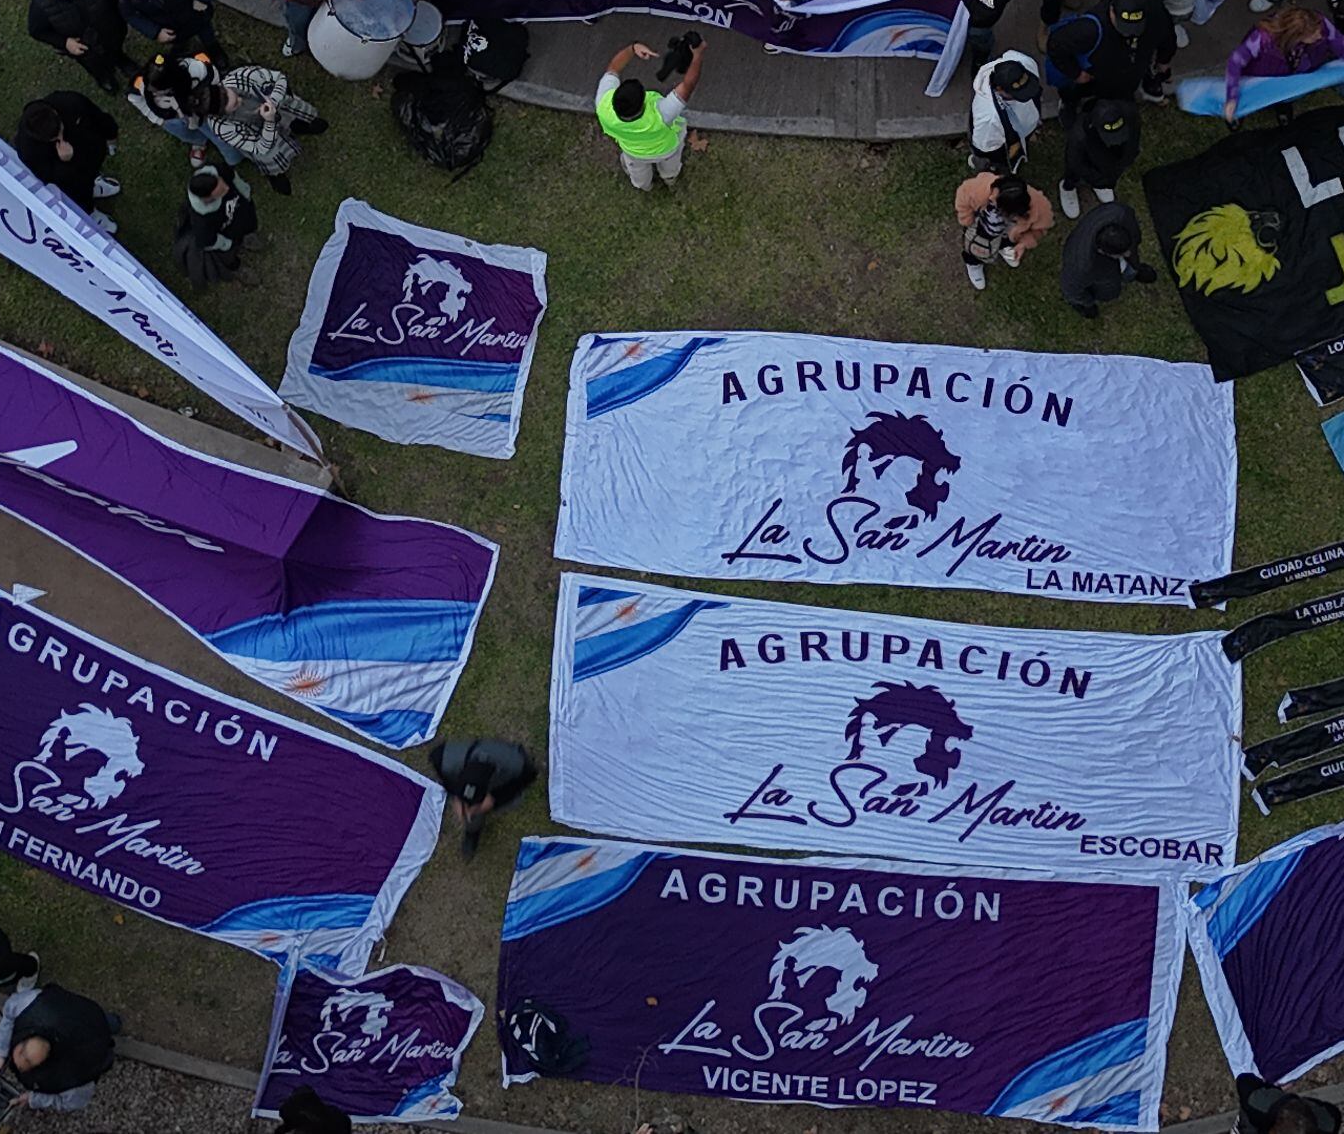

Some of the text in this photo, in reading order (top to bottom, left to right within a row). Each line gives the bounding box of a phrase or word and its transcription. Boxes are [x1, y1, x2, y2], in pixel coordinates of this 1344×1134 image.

[326, 301, 376, 345] La
[442, 316, 531, 357] Martin
[719, 358, 1076, 429] AGRUPACIÓN
[721, 497, 804, 566] La
[913, 511, 1074, 579] Martin
[1025, 567, 1201, 597] LA MATANZ
[1259, 558, 1304, 580] CIUDAD
[1295, 607, 1310, 621] LA
[716, 629, 1095, 701] AGRUPACIÓN
[722, 763, 810, 827] La
[924, 779, 1088, 845] Martin
[6, 826, 163, 909] FERNANDO
[73, 812, 207, 877] Martin
[1077, 832, 1227, 868] ESCOBAR
[657, 866, 1003, 924] AGRUPACIÓN
[369, 1026, 457, 1074] Martin
[658, 998, 732, 1058] La
[848, 1013, 976, 1073] Martin
[699, 1063, 940, 1108] VICENTE LOPEZ
